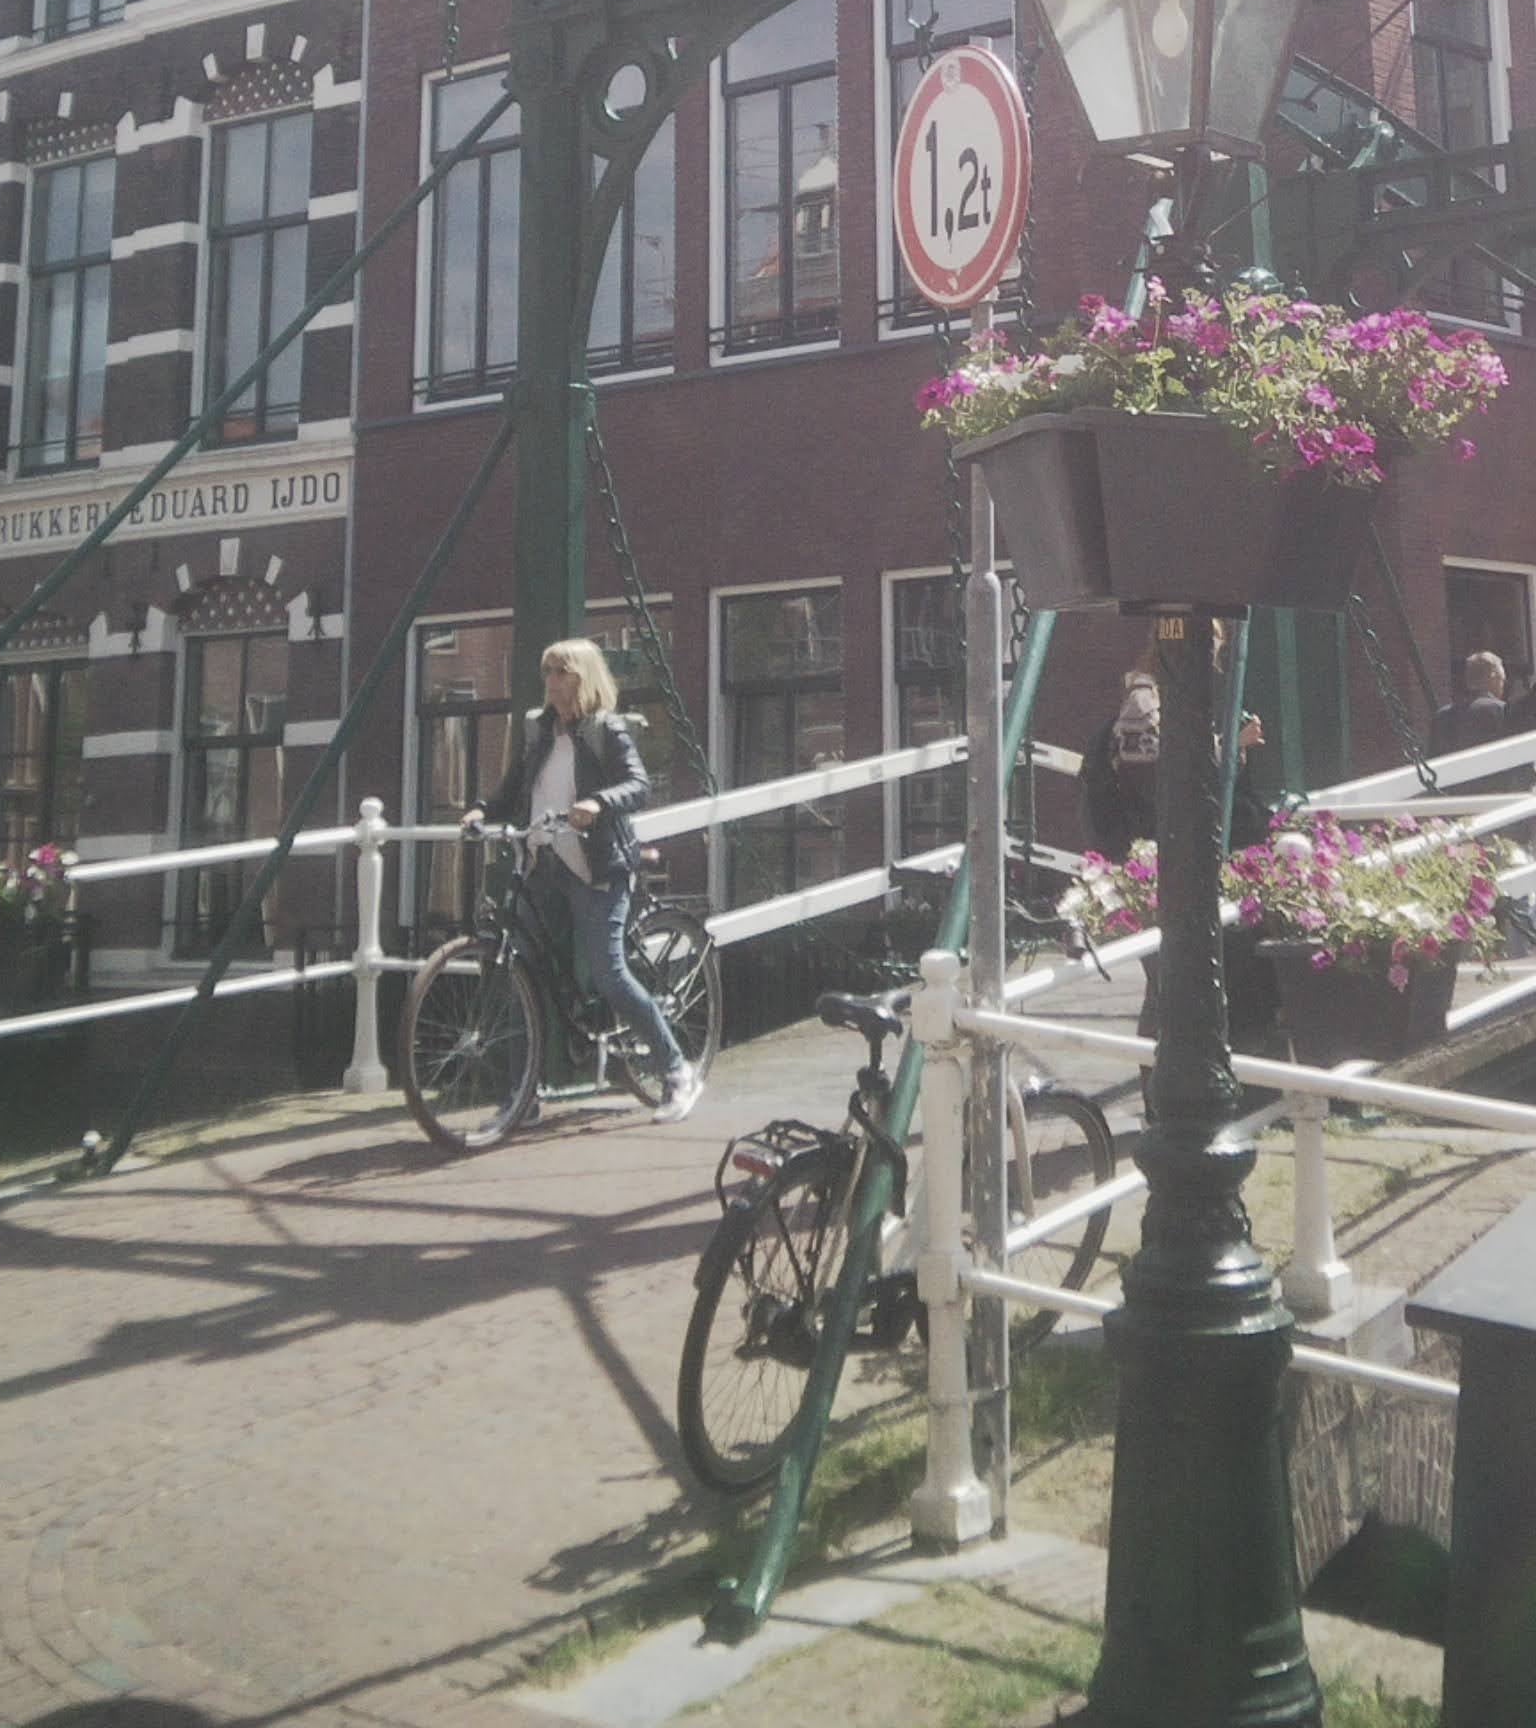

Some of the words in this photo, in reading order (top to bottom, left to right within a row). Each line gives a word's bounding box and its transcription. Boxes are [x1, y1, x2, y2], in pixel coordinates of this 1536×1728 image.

[925, 120, 992, 241] 1,2t
[128, 482, 249, 526] EDUARD
[270, 471, 342, 512] IJDO
